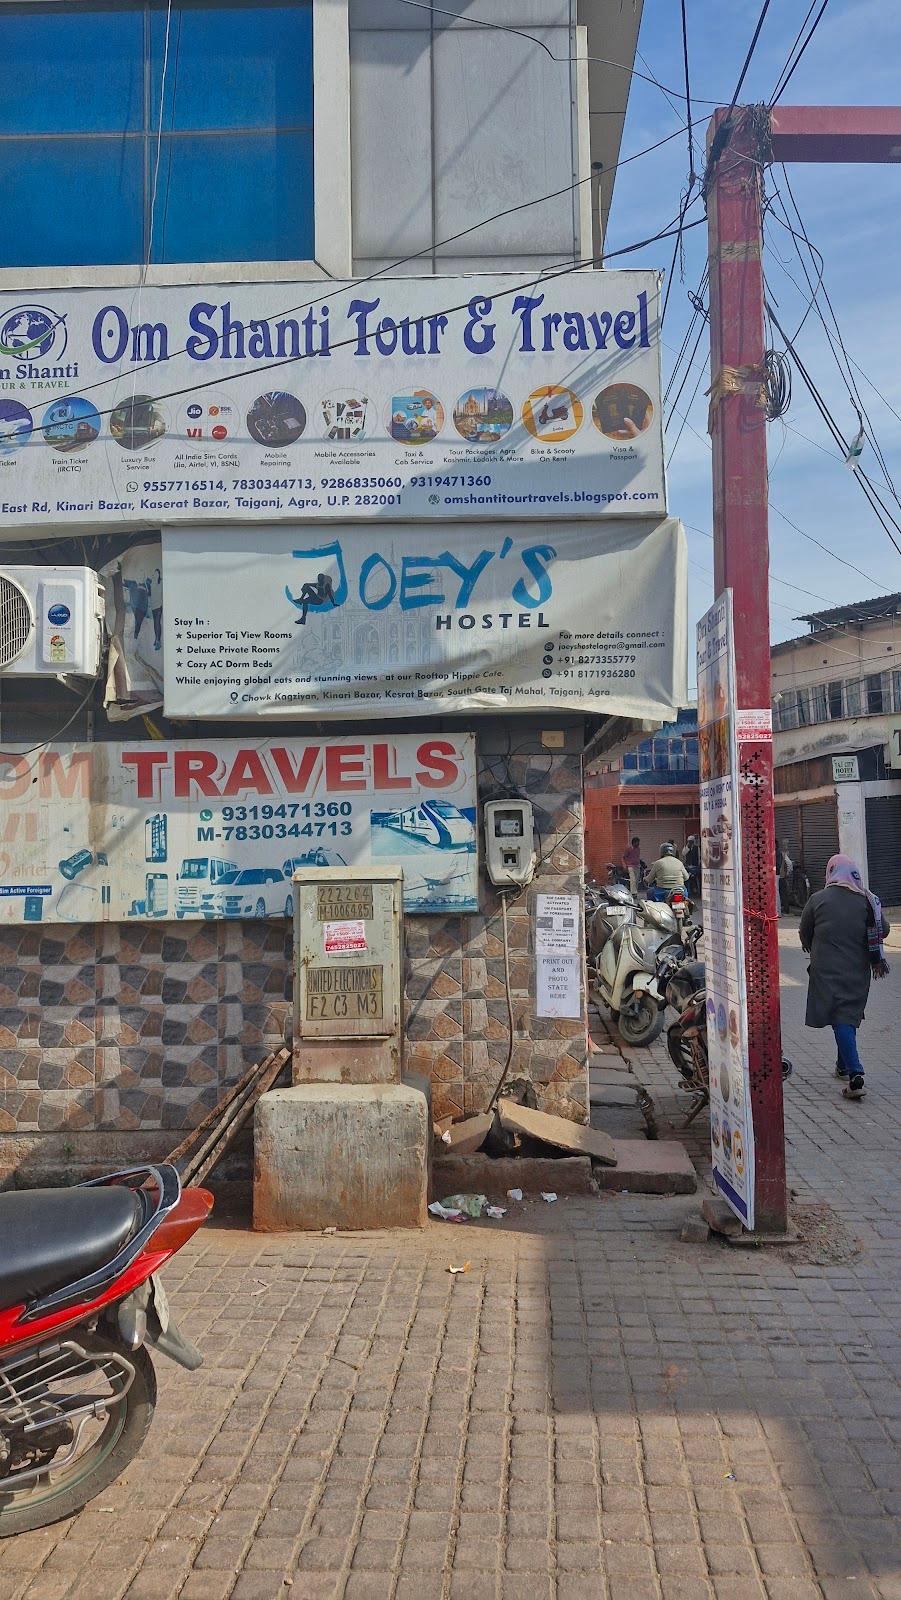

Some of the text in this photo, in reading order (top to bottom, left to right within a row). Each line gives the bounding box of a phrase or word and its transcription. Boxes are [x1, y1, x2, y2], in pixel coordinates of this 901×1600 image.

[92, 291, 651, 364] Om Shanti Tour & Travel
[16, 362, 79, 380] Shanti
[31, 380, 70, 389] TRAVEL
[143, 476, 491, 491] 9557716514, 7830344713, 9286835060, 9319471360
[2, 503, 27, 512] East
[32, 502, 51, 513] Rd,
[57, 501, 93, 511] Kinari
[99, 500, 134, 510] Bazar,
[141, 499, 188, 509] Kaserat
[193, 498, 230, 509] Bazar,
[235, 496, 283, 509] Tajganj,
[288, 497, 322, 508] Agra,
[355, 494, 400, 505] 282001
[444, 491, 658, 504] omshantitourtravels.blogspot.com
[285, 536, 557, 613] JOEY'S
[175, 618, 192, 627] Stay
[436, 612, 549, 630] HOSTEL
[186, 631, 222, 640] Superior
[225, 631, 238, 640] Taj
[187, 660, 207, 669] Cozy
[578, 655, 636, 664] 8273355779
[176, 677, 200, 685] While
[204, 676, 241, 686] enjoying
[244, 676, 271, 686] global
[415, 673, 448, 682] Rooftop
[452, 672, 480, 681] Hippie
[275, 692, 319, 702] Kagziyan,
[323, 691, 350, 699] Kinari
[354, 691, 381, 699] Bazar,
[385, 690, 414, 698] Kesrat
[418, 690, 444, 698] Bazar,
[448, 688, 472, 696] South
[475, 686, 496, 694] Gate
[500, 686, 512, 696] Taj
[515, 687, 546, 696] Mahal,
[550, 688, 584, 697] Tajganj,
[588, 688, 610, 697] Agra
[122, 741, 459, 798] TRAVELS
[222, 801, 352, 821] 9319471360
[198, 822, 353, 841] M-7830344713
[14, 864, 48, 878] airtel
[27, 887, 51, 895] Foreigner
[308, 970, 332, 992] UNITED
